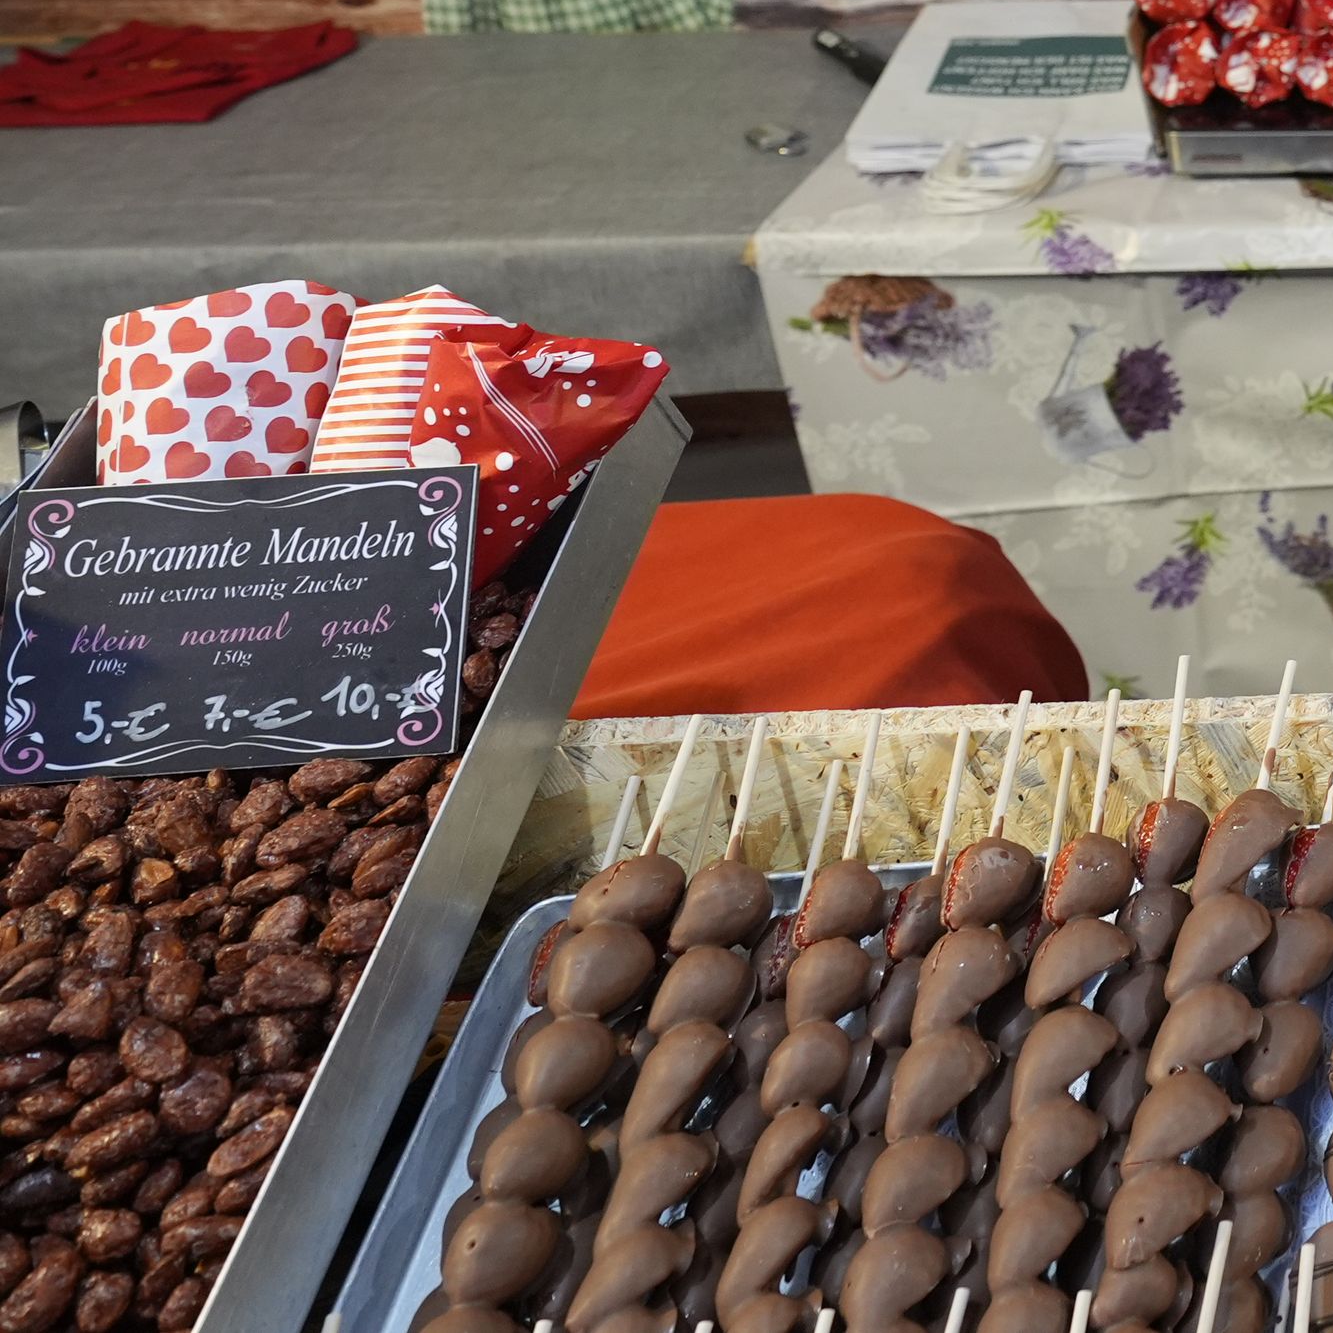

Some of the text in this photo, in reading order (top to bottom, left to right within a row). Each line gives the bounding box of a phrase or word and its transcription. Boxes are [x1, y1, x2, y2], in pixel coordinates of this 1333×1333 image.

[64, 519, 415, 578] Gebrannte Mandeln
[118, 573, 369, 606] mit extra wenig Zucker
[70, 603, 396, 655] klein normal groß
[87, 641, 373, 676] 100g 150g 250g
